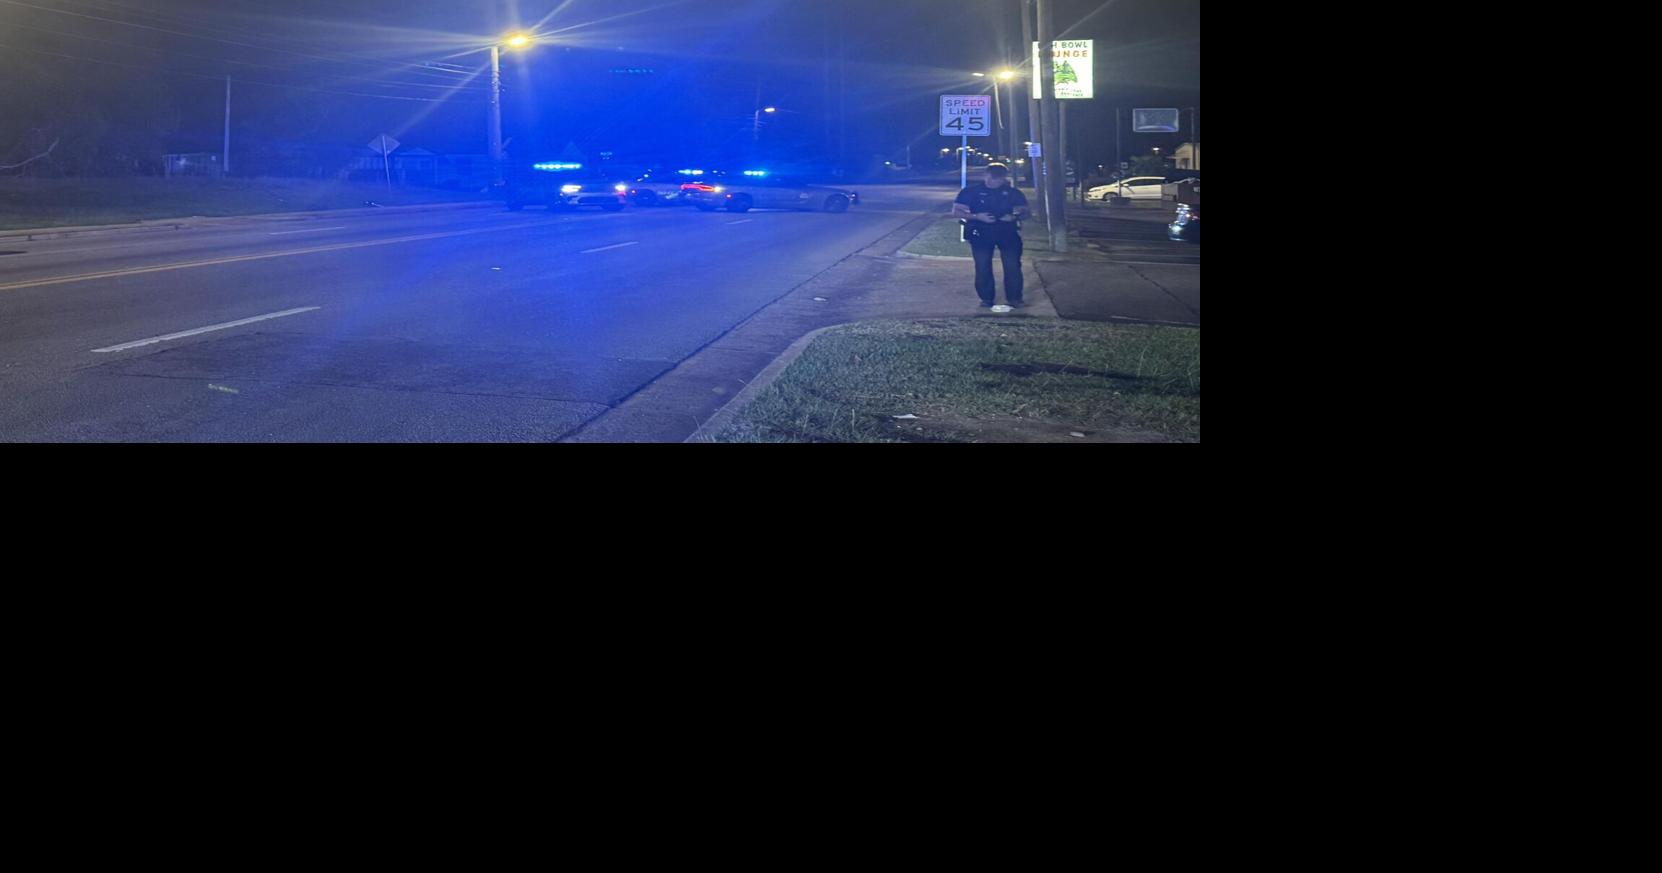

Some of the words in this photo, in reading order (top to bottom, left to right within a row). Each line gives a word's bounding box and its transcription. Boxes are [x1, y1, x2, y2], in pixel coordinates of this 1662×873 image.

[1061, 41, 1088, 49] BOWL
[1038, 50, 1088, 58] UNGE
[945, 99, 985, 107] SPEED
[945, 117, 984, 131] 45
